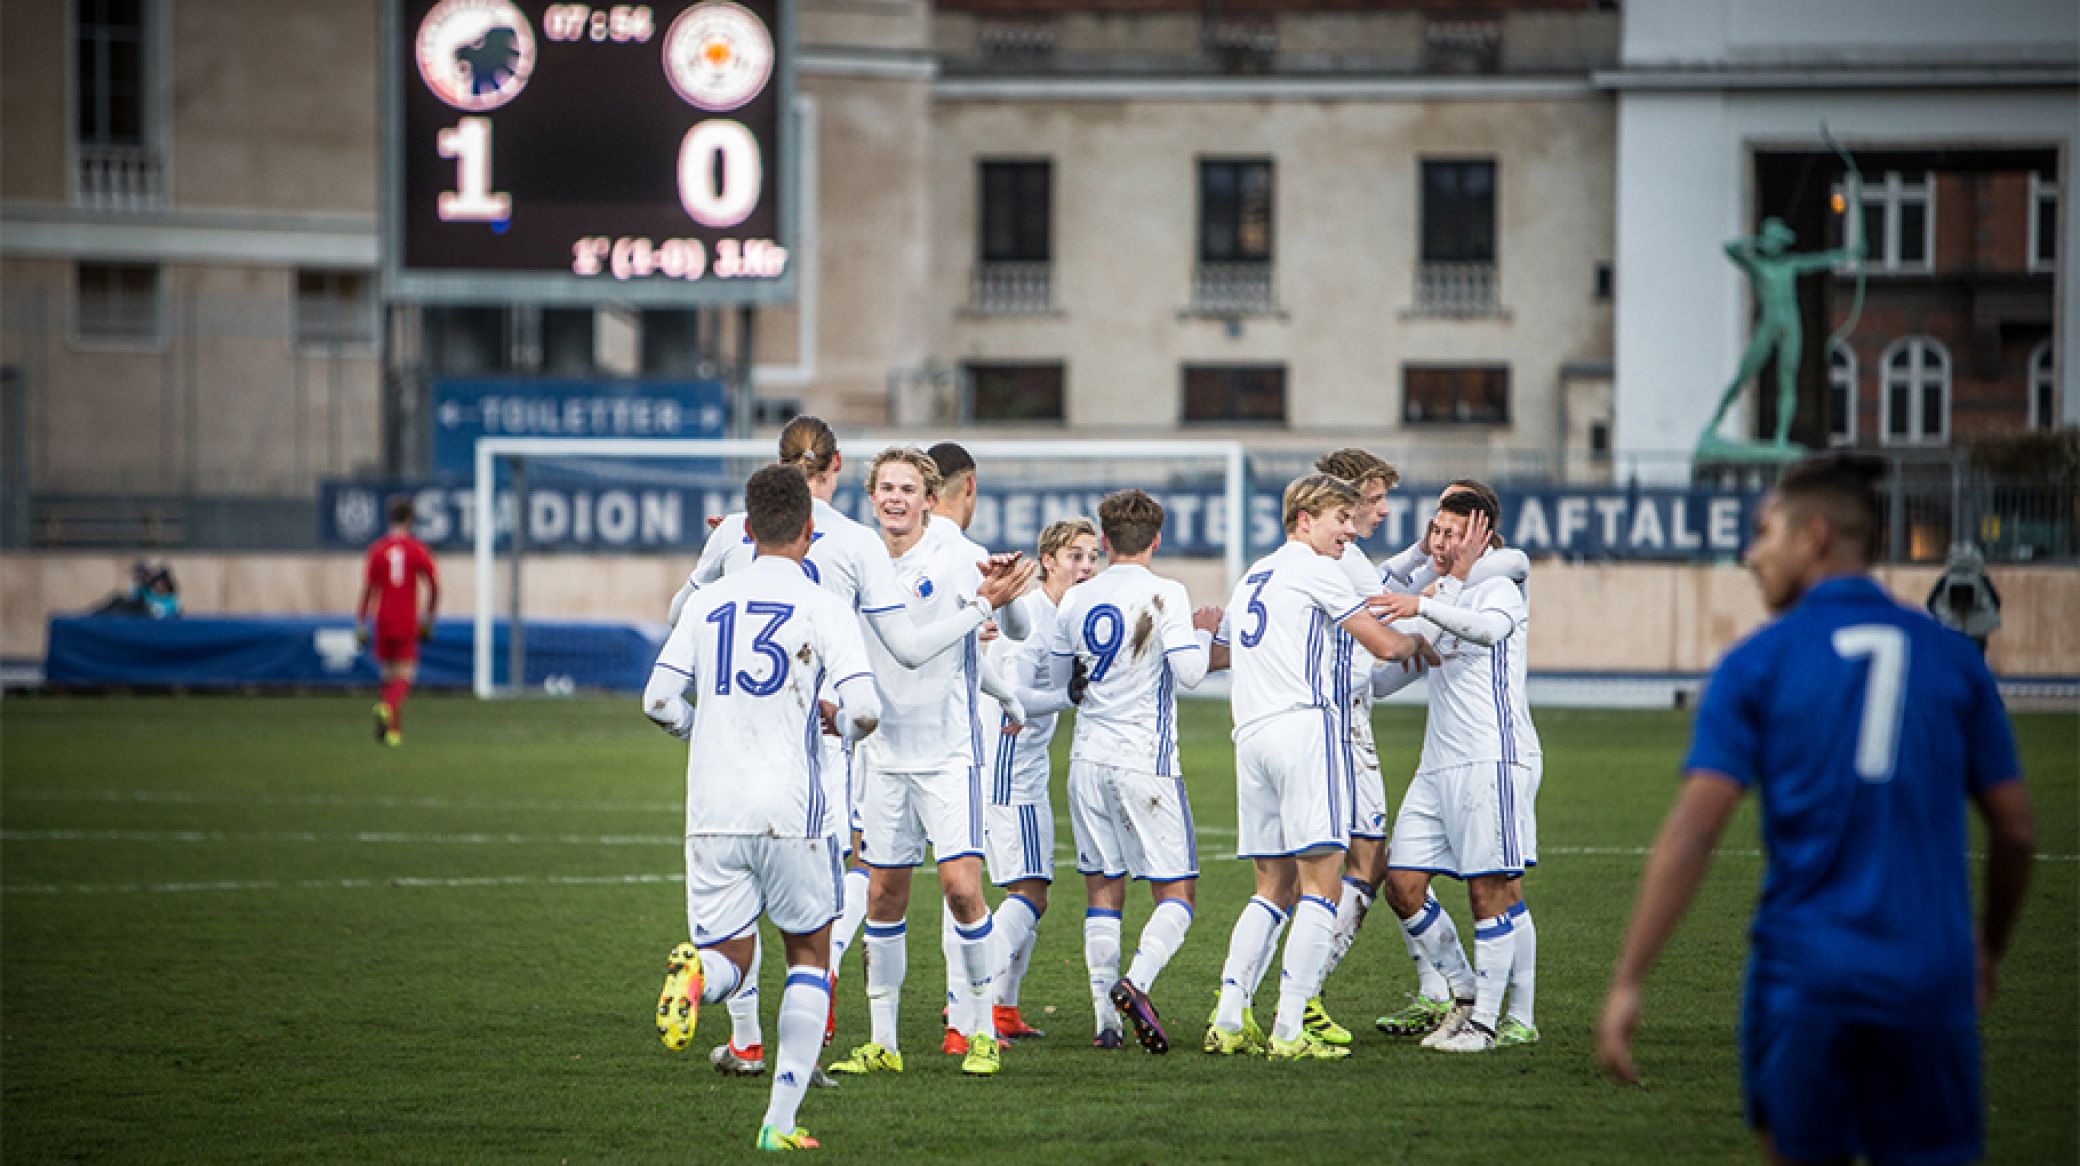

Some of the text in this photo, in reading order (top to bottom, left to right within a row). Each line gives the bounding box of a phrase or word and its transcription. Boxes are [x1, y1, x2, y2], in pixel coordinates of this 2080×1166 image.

[436, 116, 763, 228] 1 0
[481, 398, 681, 433] TOILETTER
[1514, 496, 1742, 548] AFTALE
[386, 544, 405, 587] 1
[1083, 602, 1125, 682] 9
[1240, 568, 1275, 648] 3
[706, 601, 795, 697] 13
[1830, 624, 1911, 783] 7
